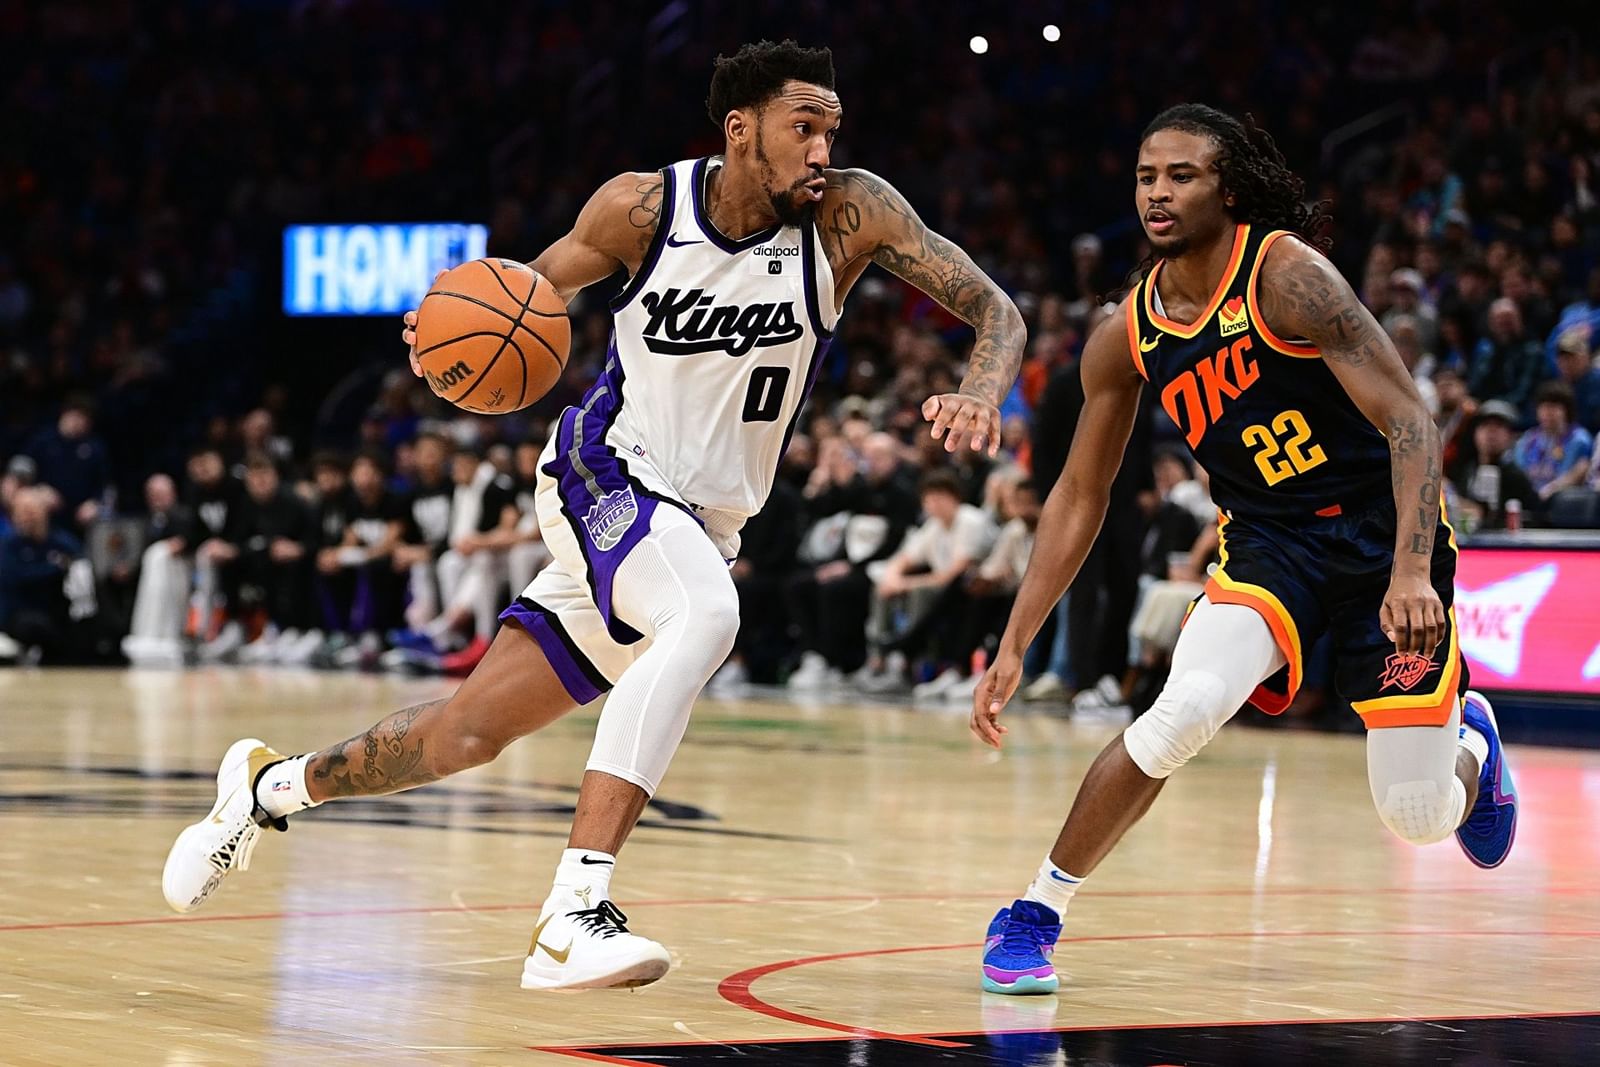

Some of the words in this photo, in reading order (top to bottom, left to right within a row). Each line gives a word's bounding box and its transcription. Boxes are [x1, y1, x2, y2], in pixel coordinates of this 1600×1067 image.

[753, 245, 799, 259] dialpad
[641, 288, 804, 357] Kings
[425, 360, 476, 392] lson
[741, 366, 791, 423] 0
[1161, 334, 1261, 451] OKC
[1241, 409, 1329, 488] 22
[1385, 660, 1421, 683] OKC
